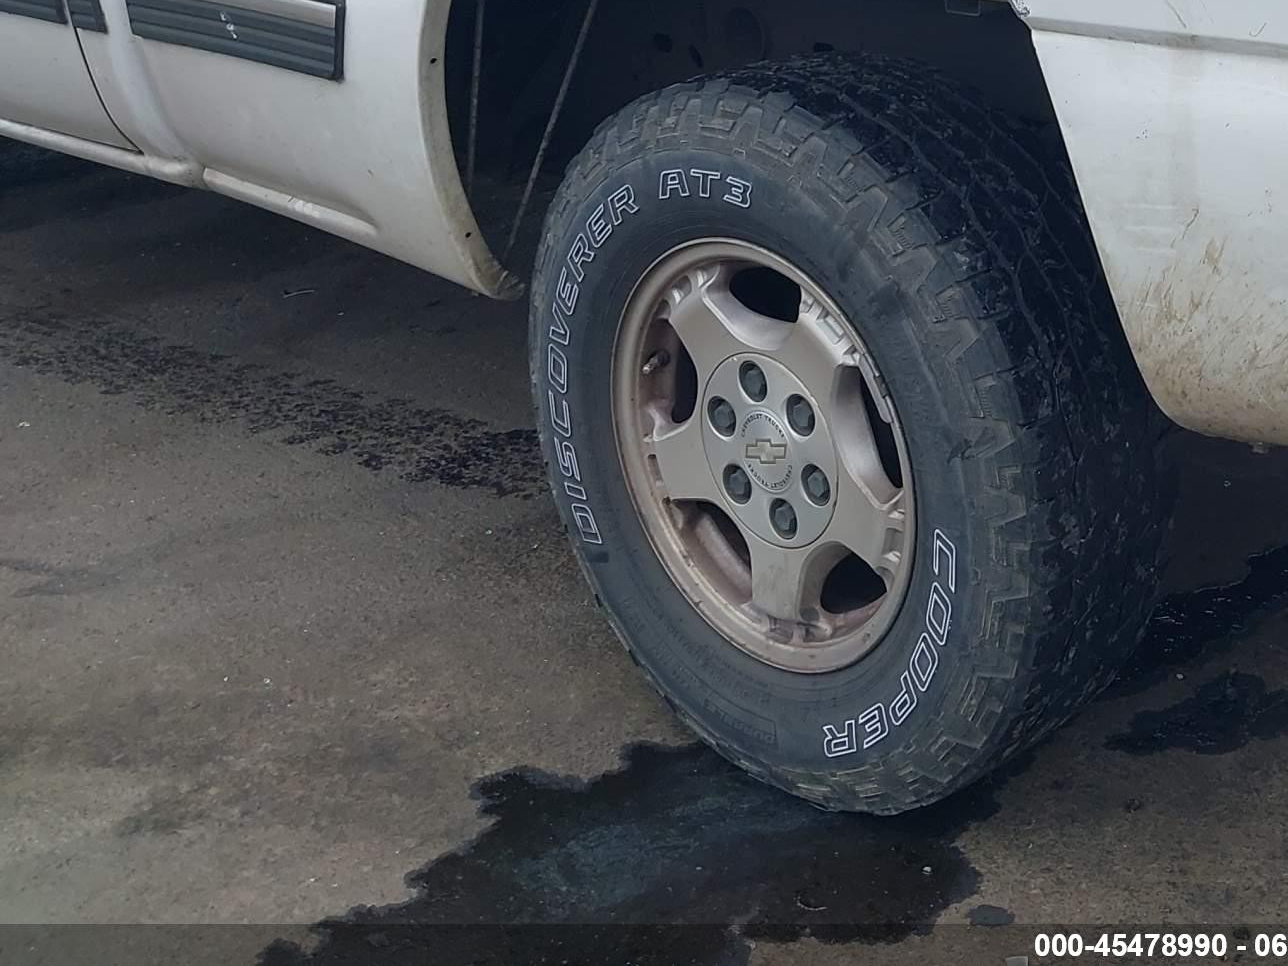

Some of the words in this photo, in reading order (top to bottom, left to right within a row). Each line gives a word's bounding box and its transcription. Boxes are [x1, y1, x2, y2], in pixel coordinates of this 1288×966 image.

[547, 184, 640, 545] DISCOVERER
[658, 168, 753, 208] AT3
[823, 529, 956, 757] COOPER
